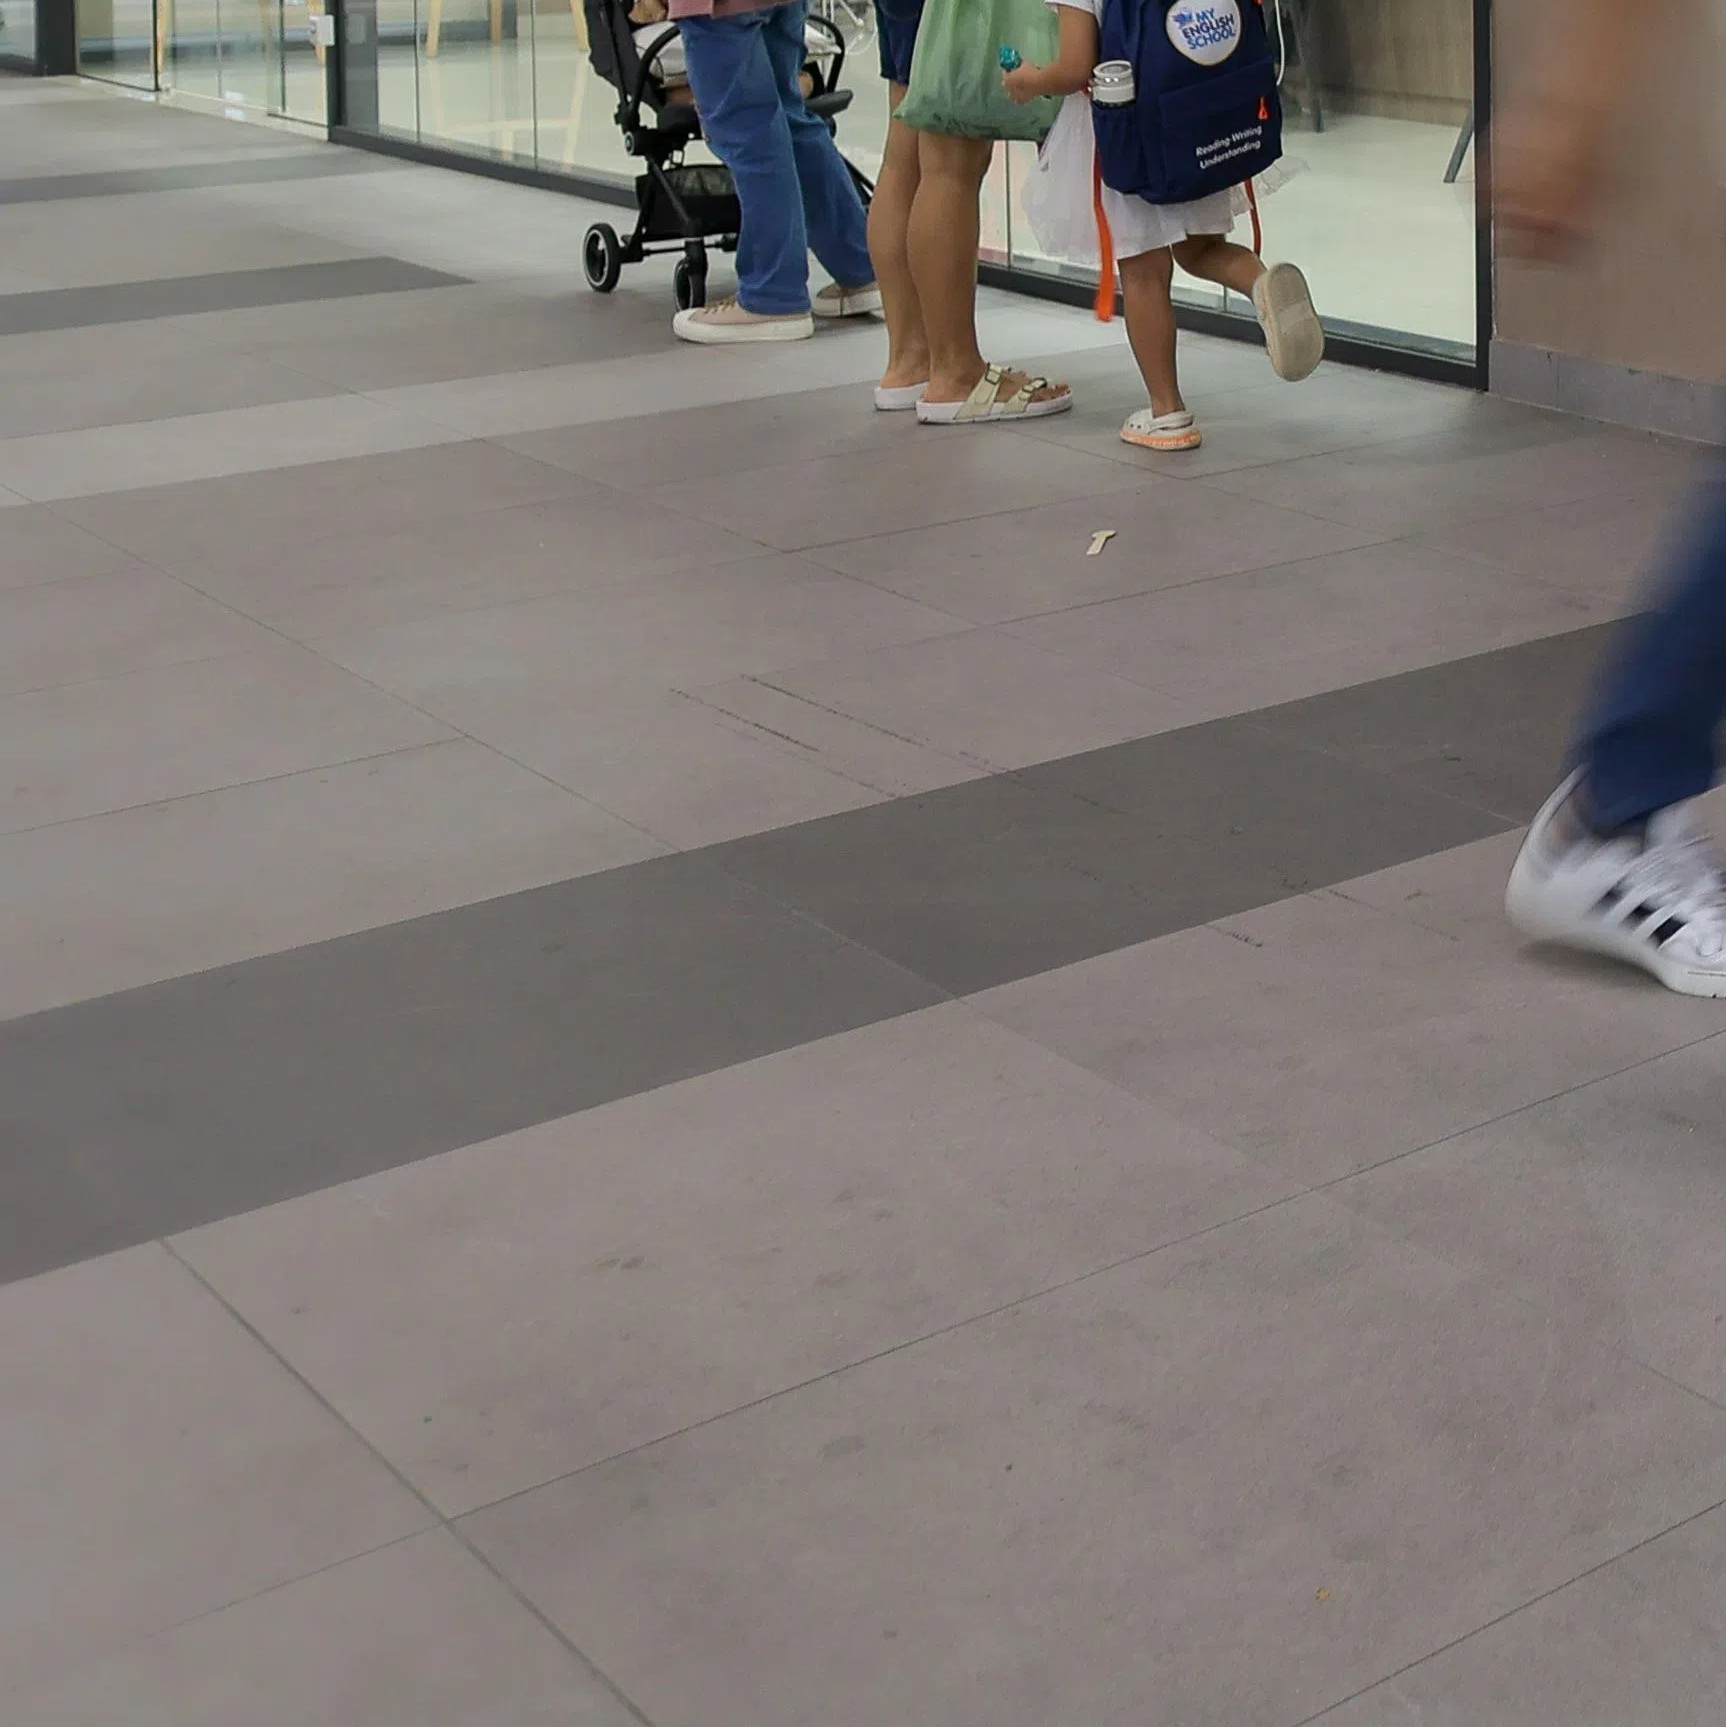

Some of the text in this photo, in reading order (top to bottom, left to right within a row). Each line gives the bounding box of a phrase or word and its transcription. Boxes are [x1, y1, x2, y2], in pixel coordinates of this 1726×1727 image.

[1182, 14, 1235, 39] ENGLISH
[1195, 7, 1215, 23] MY
[1187, 27, 1236, 50] SCHOOL
[1200, 139, 1261, 169] Understanding
